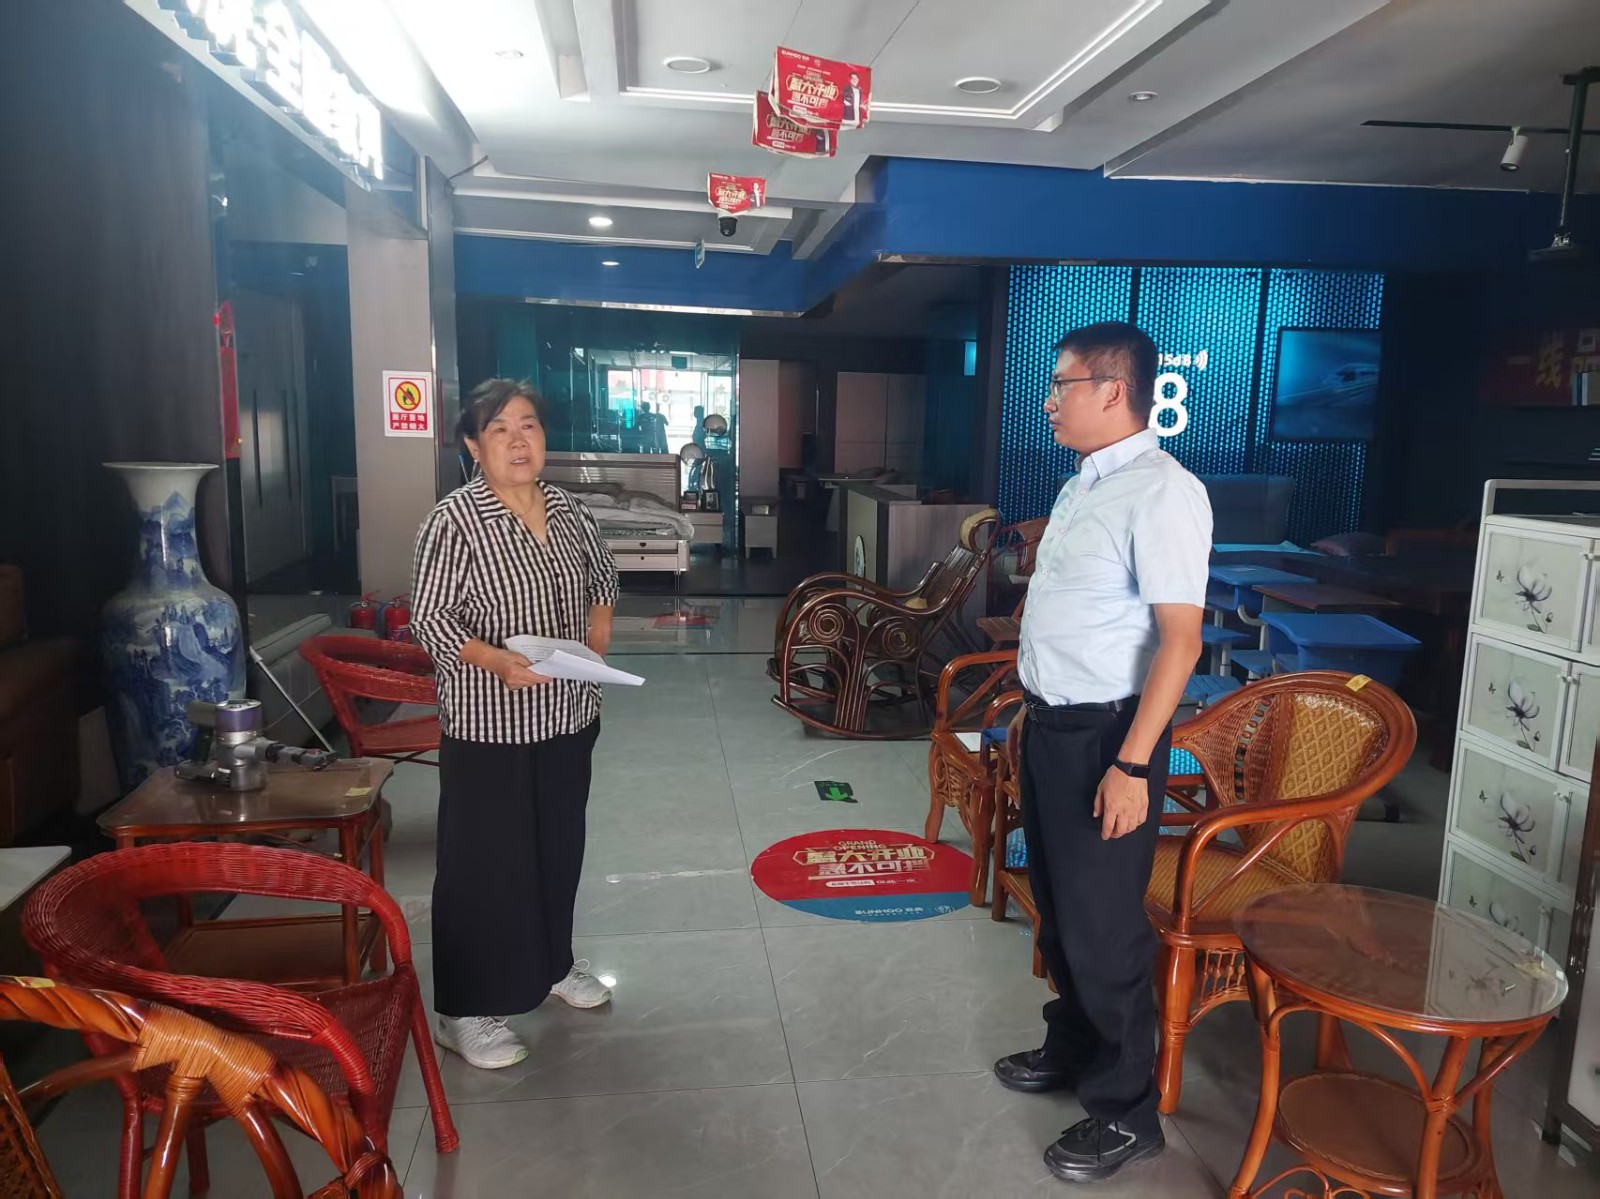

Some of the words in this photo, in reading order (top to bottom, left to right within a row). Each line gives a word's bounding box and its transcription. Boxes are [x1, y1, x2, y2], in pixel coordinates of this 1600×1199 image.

[392, 422, 425, 430] 严禁烟火
[807, 848, 926, 863] 盛大开业
